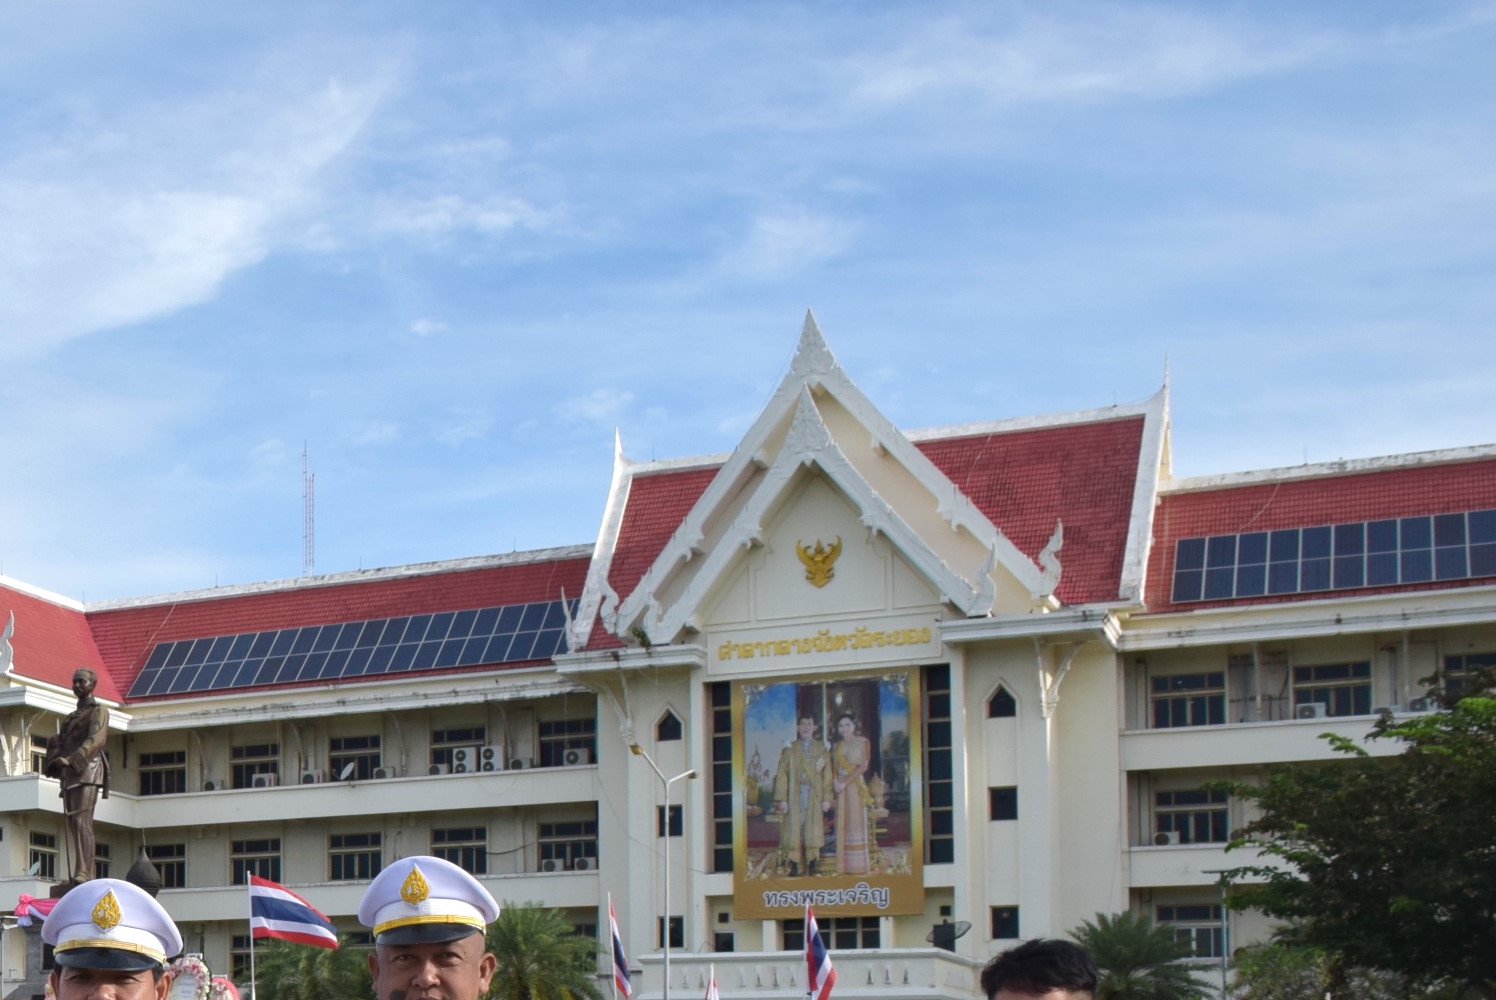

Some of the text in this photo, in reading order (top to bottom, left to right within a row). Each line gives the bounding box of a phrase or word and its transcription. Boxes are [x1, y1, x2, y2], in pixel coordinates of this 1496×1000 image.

[718, 626, 931, 660] ศาลากลางจังหวัดระยอง
[764, 882, 889, 908] ทรงพระเจริญ
